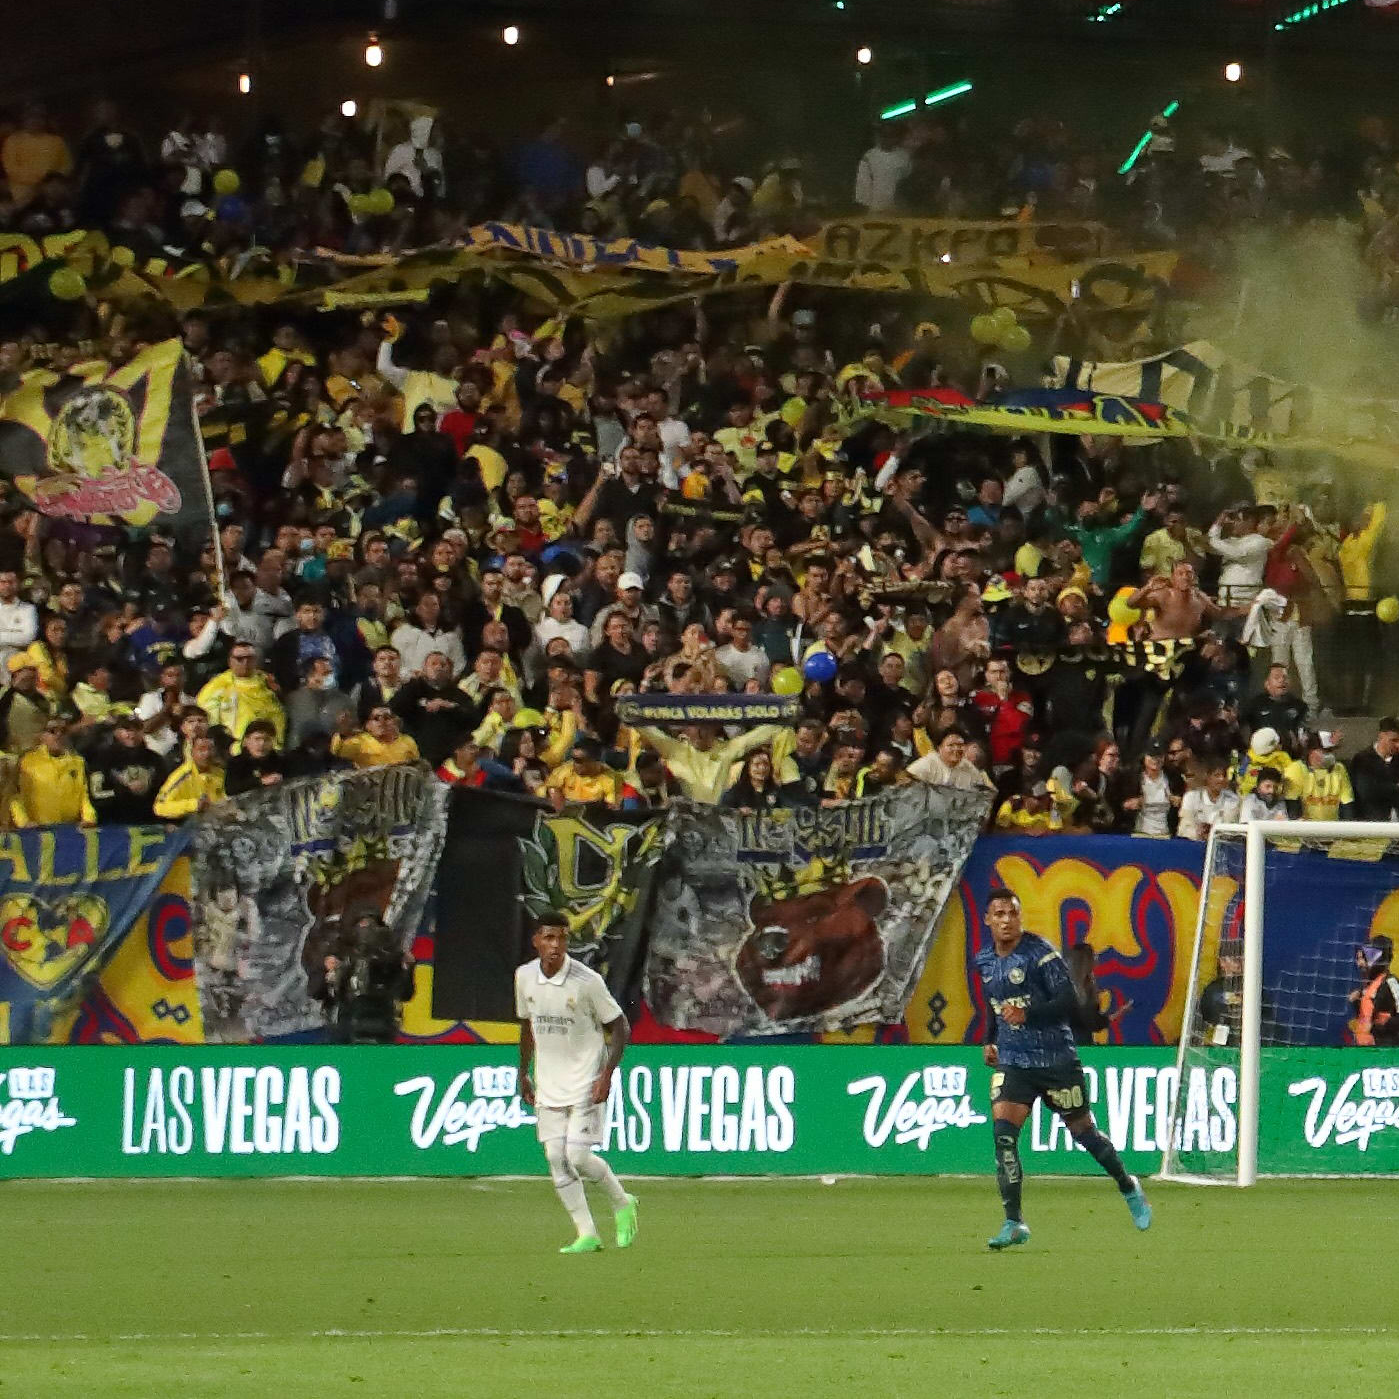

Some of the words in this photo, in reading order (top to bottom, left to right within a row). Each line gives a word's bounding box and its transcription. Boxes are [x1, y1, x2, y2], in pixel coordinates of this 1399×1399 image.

[122, 1066, 194, 1154] LAS
[201, 1066, 341, 1154] VEGAS
[394, 1071, 537, 1152] Vegas
[592, 1067, 651, 1153] AS
[659, 1066, 795, 1152] VEGAS
[847, 1067, 987, 1152] Vegas
[1105, 1067, 1237, 1153] VEGAS
